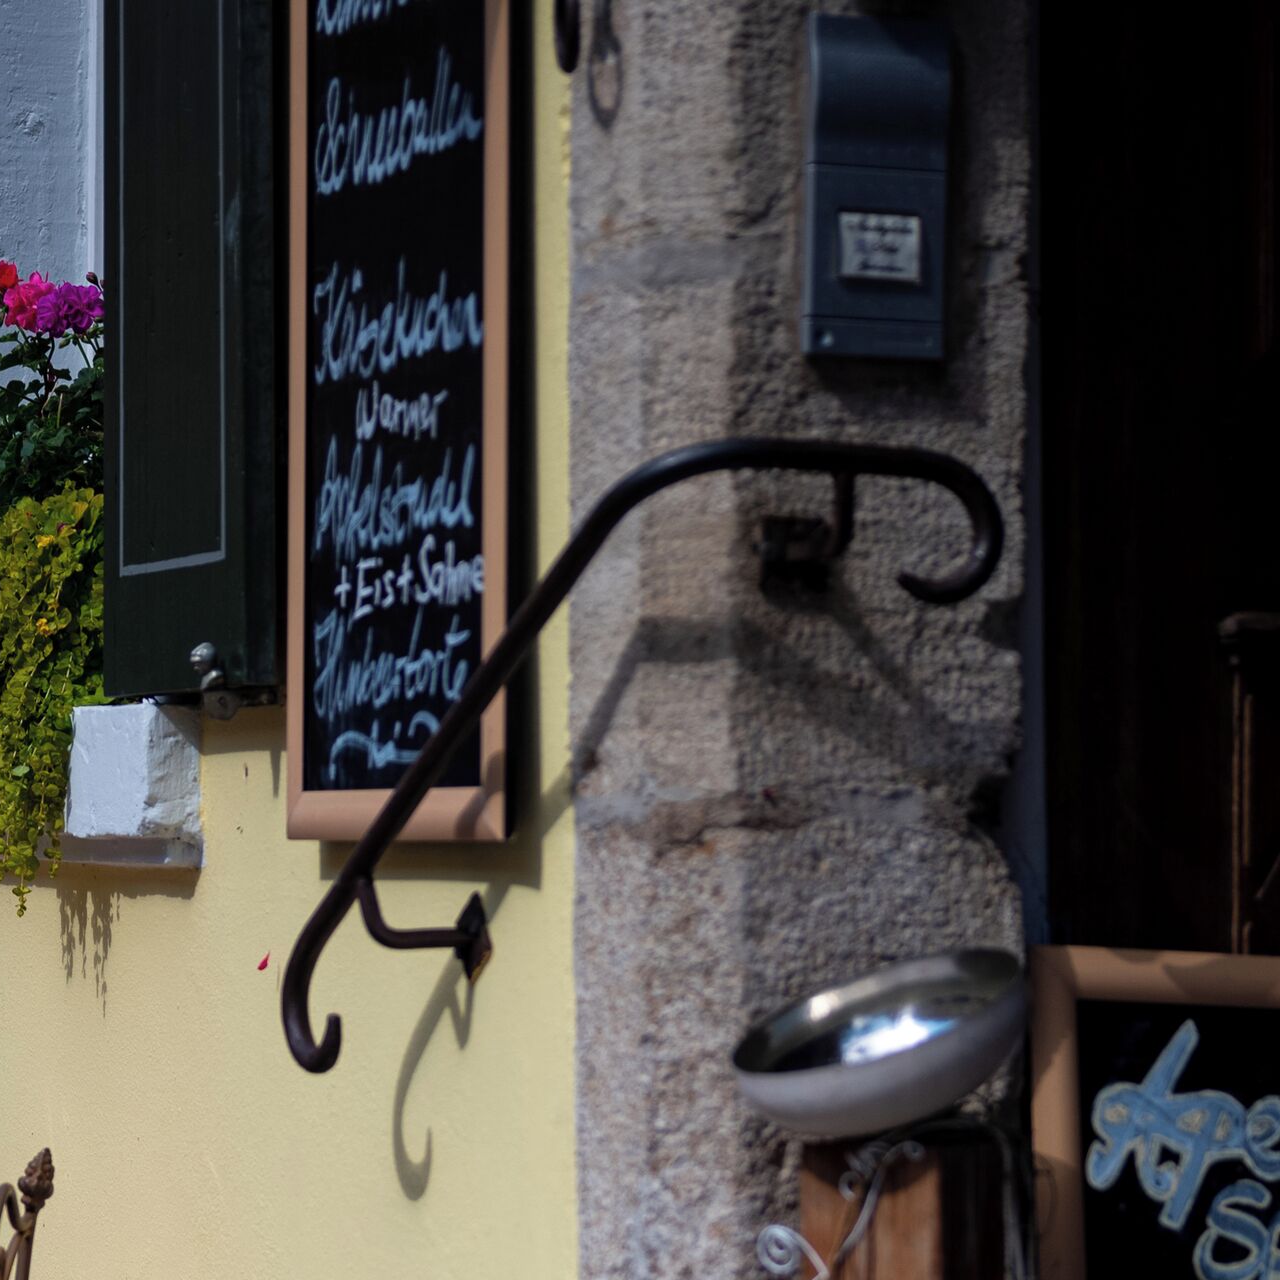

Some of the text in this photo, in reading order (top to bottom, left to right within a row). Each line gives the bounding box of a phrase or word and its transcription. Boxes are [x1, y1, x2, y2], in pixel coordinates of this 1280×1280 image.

[314, 253, 484, 386] Käsekuchen
[355, 379, 450, 443] Warmer
[314, 433, 476, 571] Apfelstrudel
